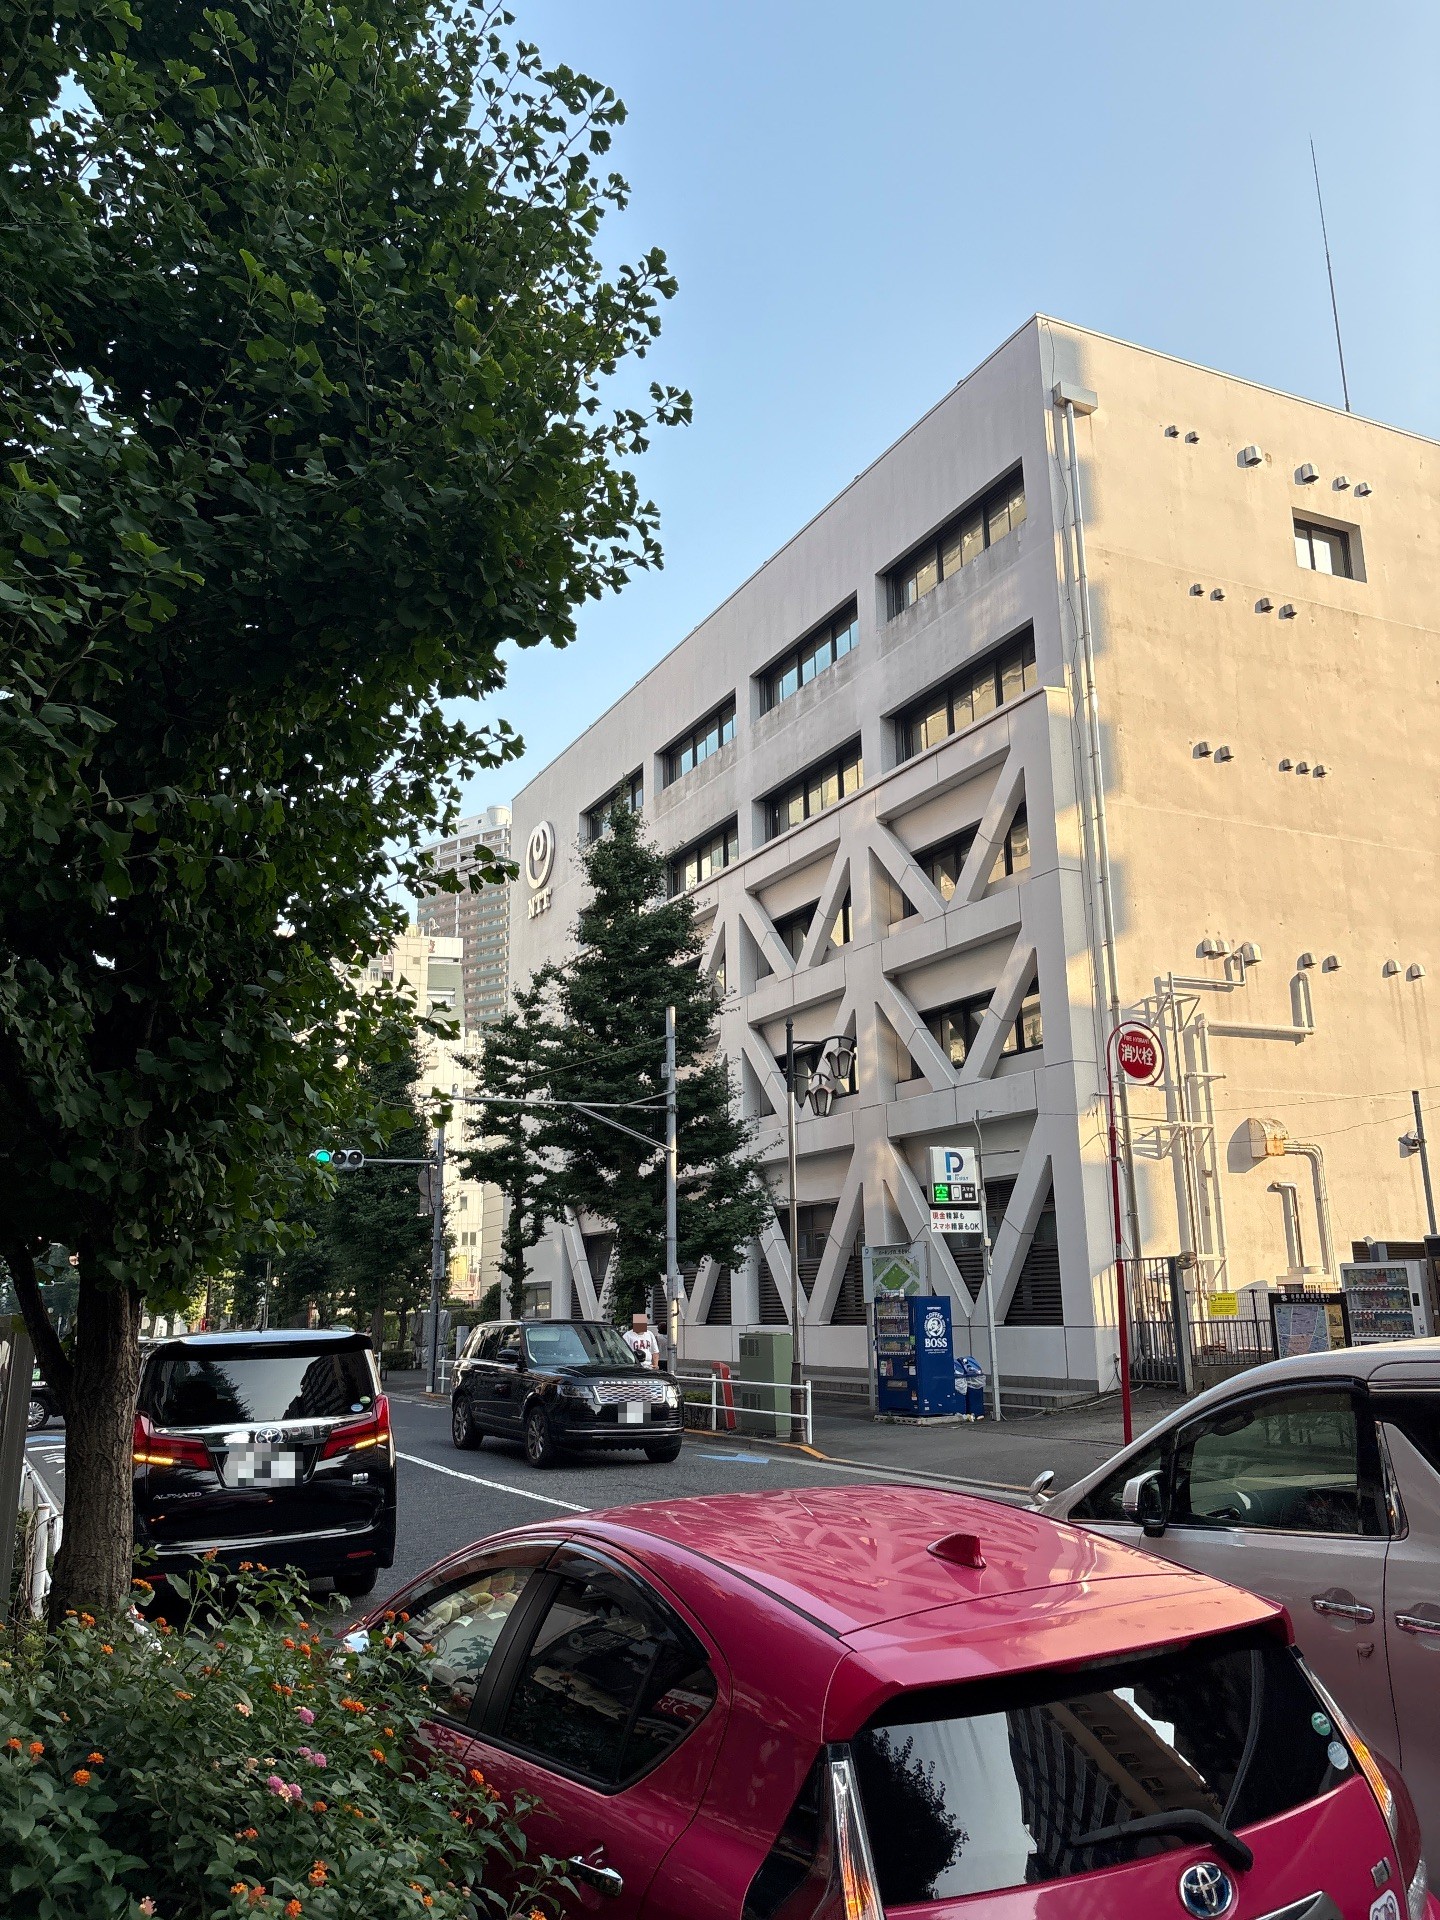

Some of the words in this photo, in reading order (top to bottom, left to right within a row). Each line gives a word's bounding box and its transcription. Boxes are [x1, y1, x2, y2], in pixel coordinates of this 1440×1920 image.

[528, 887, 550, 920] NTT
[1120, 1043, 1154, 1066] 消火栓
[934, 1184, 949, 1201] 空
[932, 1211, 965, 1220] 現金精算も
[932, 1222, 980, 1231] スマホ精算もOK
[925, 1311, 943, 1320] COFFEE
[924, 1338, 948, 1348] BOSS
[153, 1492, 202, 1500] ALPHARD
